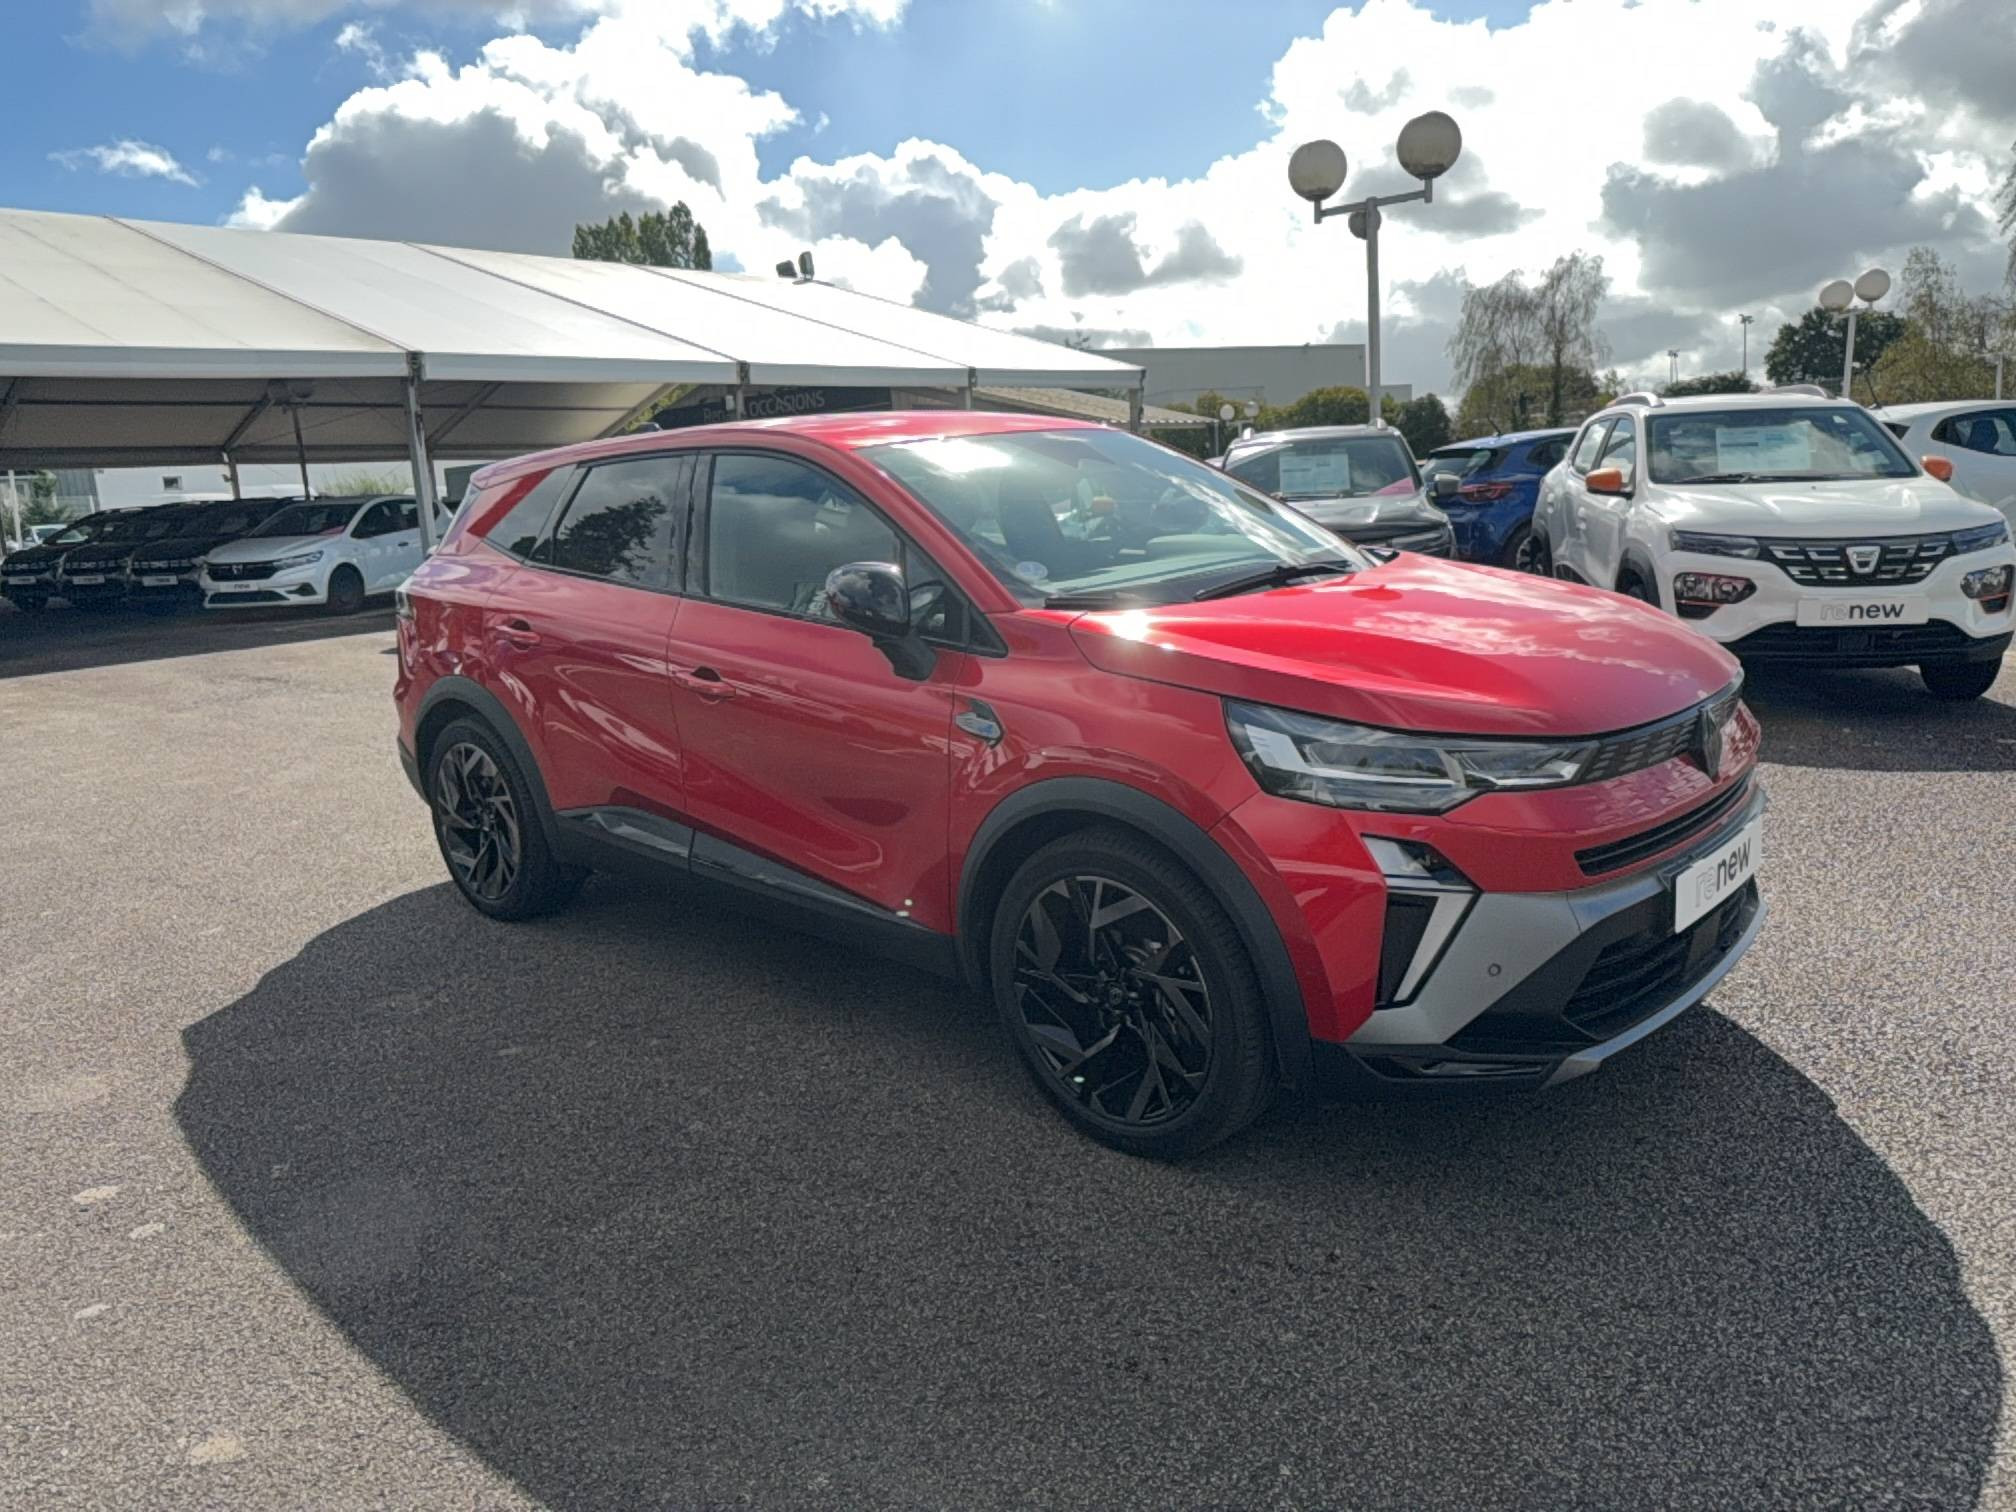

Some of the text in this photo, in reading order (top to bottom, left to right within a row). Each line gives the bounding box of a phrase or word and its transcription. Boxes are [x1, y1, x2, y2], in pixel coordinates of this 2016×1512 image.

[750, 390, 825, 417] OCCASIONS
[1820, 603, 1904, 621] renew
[1695, 837, 1751, 908] renew
